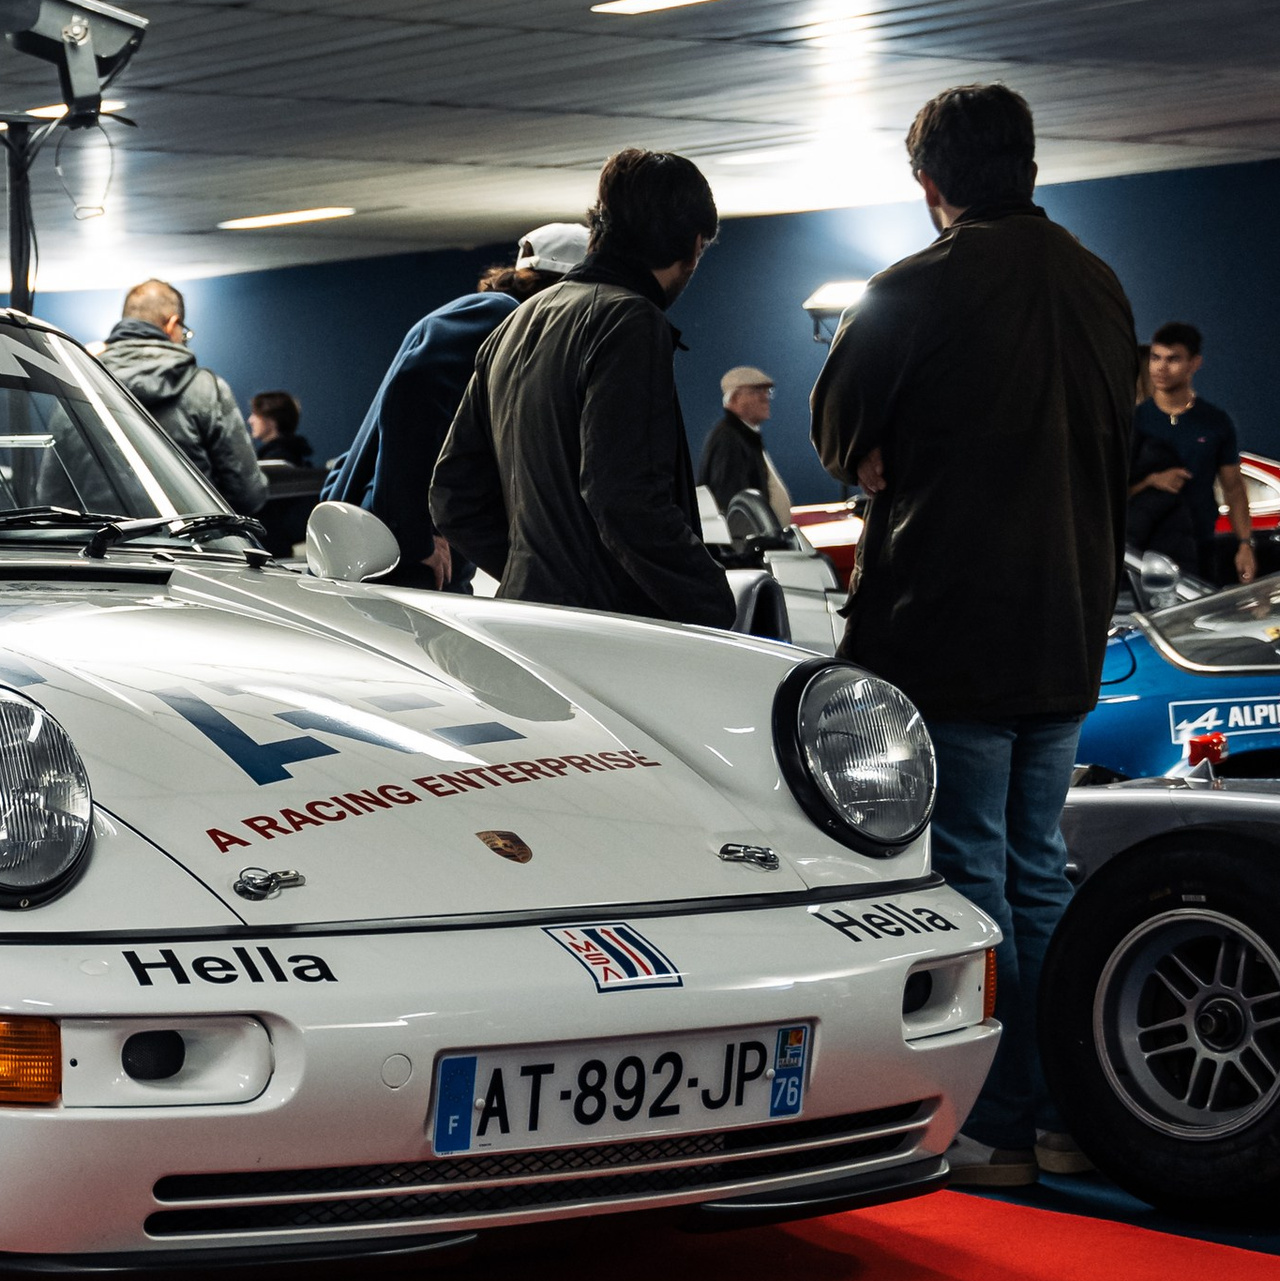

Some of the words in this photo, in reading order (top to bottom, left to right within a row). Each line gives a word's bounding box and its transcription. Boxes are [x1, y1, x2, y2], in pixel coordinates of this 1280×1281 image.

[1228, 703, 1280, 728] ALPI
[205, 828, 252, 853] A
[240, 784, 422, 842] RACING
[413, 750, 662, 799] ENTERPRISE
[811, 903, 960, 942] Hella
[121, 946, 338, 987] Hella
[563, 930, 623, 982] IMSA
[448, 1115, 460, 1136] F
[476, 1041, 767, 1136] AT-892-JP
[774, 1076, 799, 1108] 76
